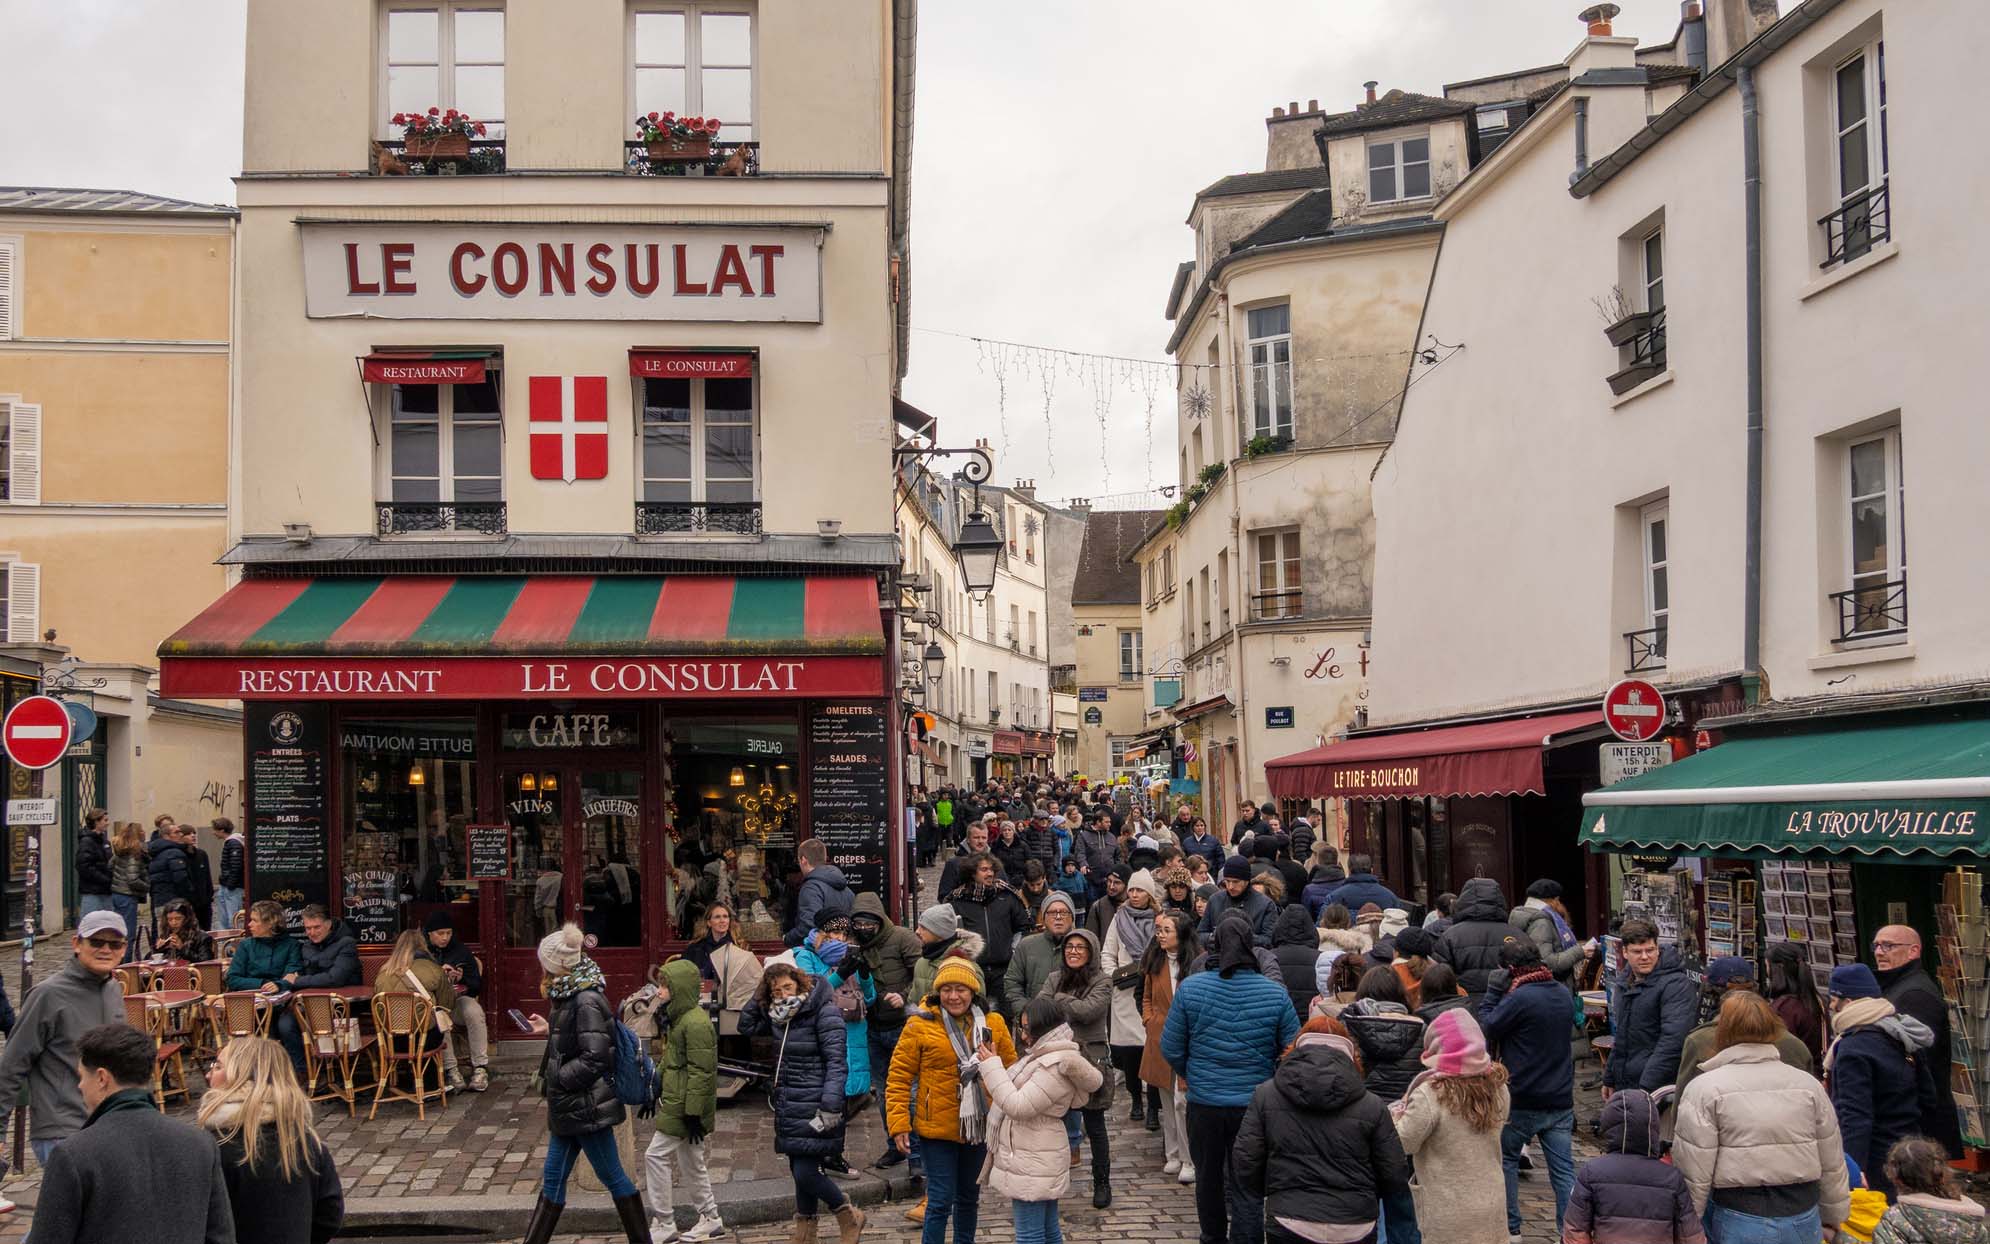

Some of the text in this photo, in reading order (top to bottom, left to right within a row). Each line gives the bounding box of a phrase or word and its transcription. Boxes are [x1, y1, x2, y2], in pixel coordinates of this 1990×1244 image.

[342, 241, 784, 298] LE CONSULAT
[383, 366, 467, 379] RESTAURANT
[645, 360, 737, 373] LE CONSULAT
[1304, 647, 1344, 679] Le
[239, 669, 442, 693] RESTAURANT
[521, 661, 804, 692] LE CONSULAT
[826, 706, 873, 715] OMELETTES
[1612, 746, 1661, 756] INTERDIT
[830, 754, 867, 763] SALADES
[1622, 767, 1638, 775] AUF
[1334, 771, 1344, 788] LE
[510, 799, 553, 814] VINS
[582, 799, 639, 818] LIQUEURS
[276, 815, 300, 823] PLATS
[1785, 808, 1976, 838] LA TROUVAILLE
[365, 870, 395, 882] CHAUD
